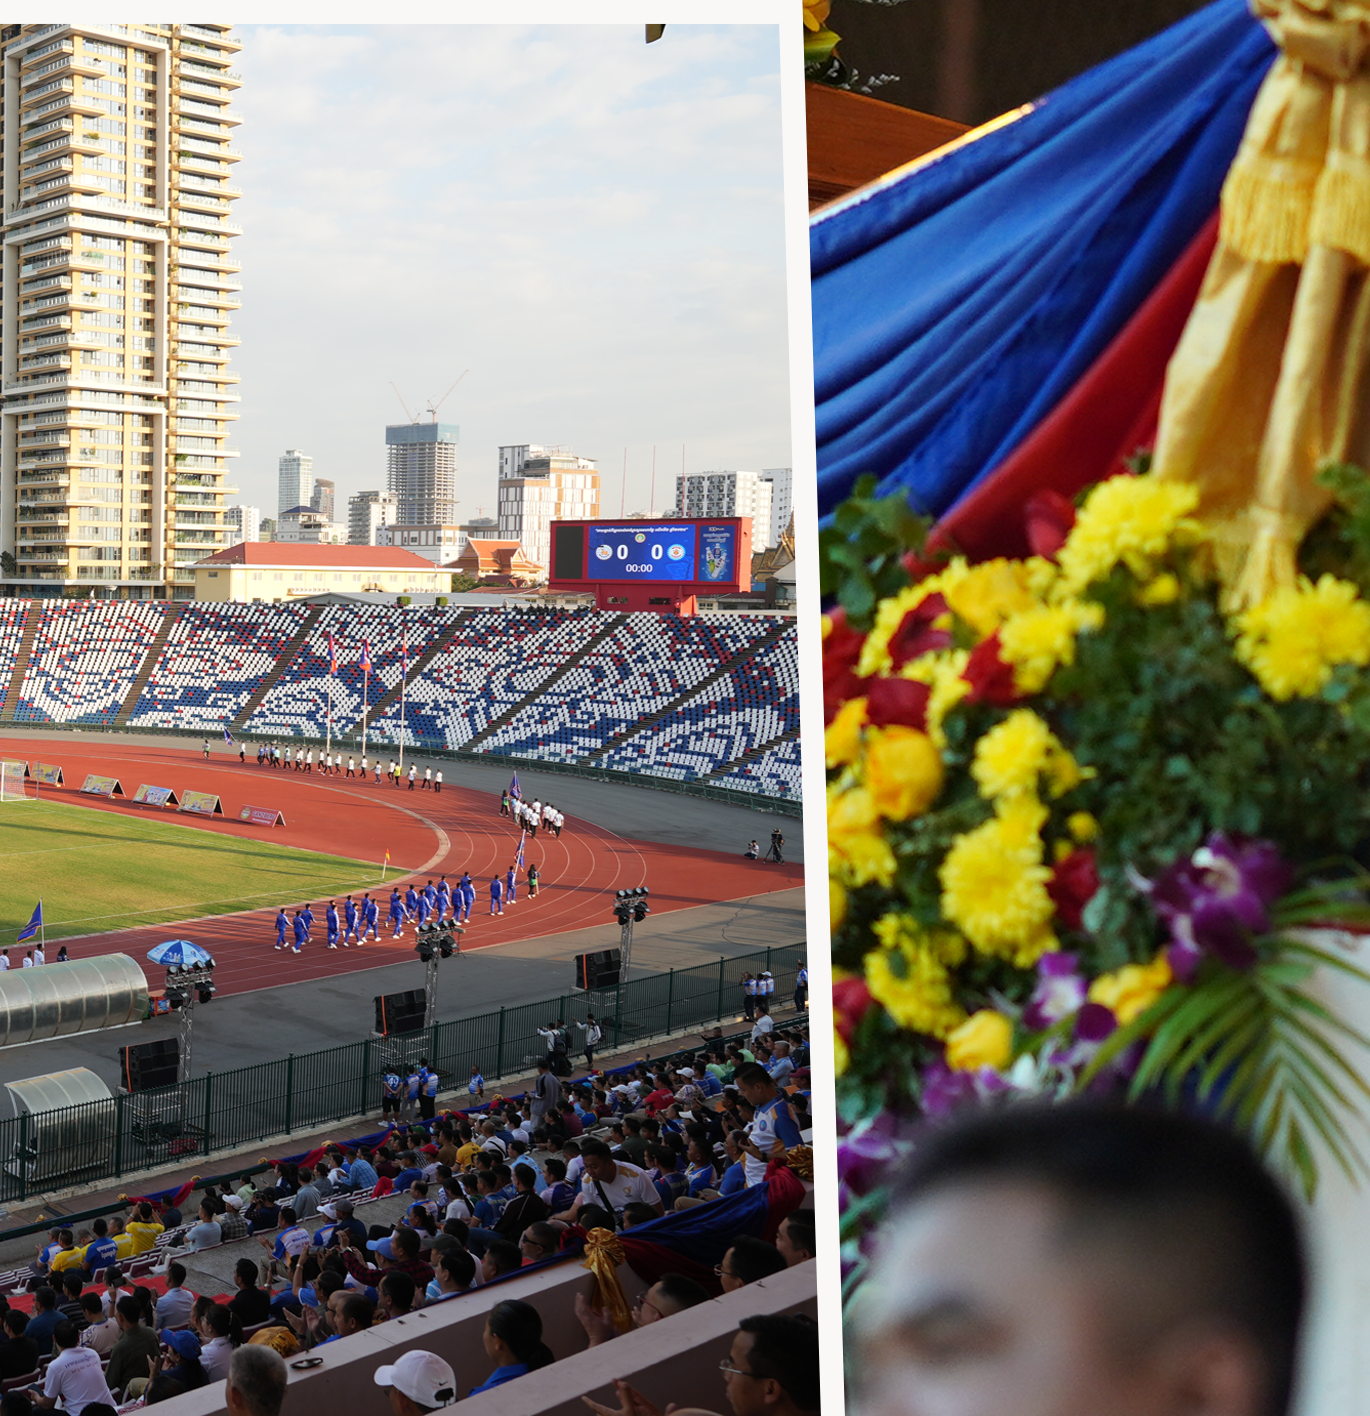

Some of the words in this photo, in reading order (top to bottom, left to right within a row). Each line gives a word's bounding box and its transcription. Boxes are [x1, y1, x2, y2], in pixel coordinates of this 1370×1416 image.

[617, 544, 628, 560] 0
[651, 544, 663, 560] 0
[625, 563, 653, 573] 00:00
